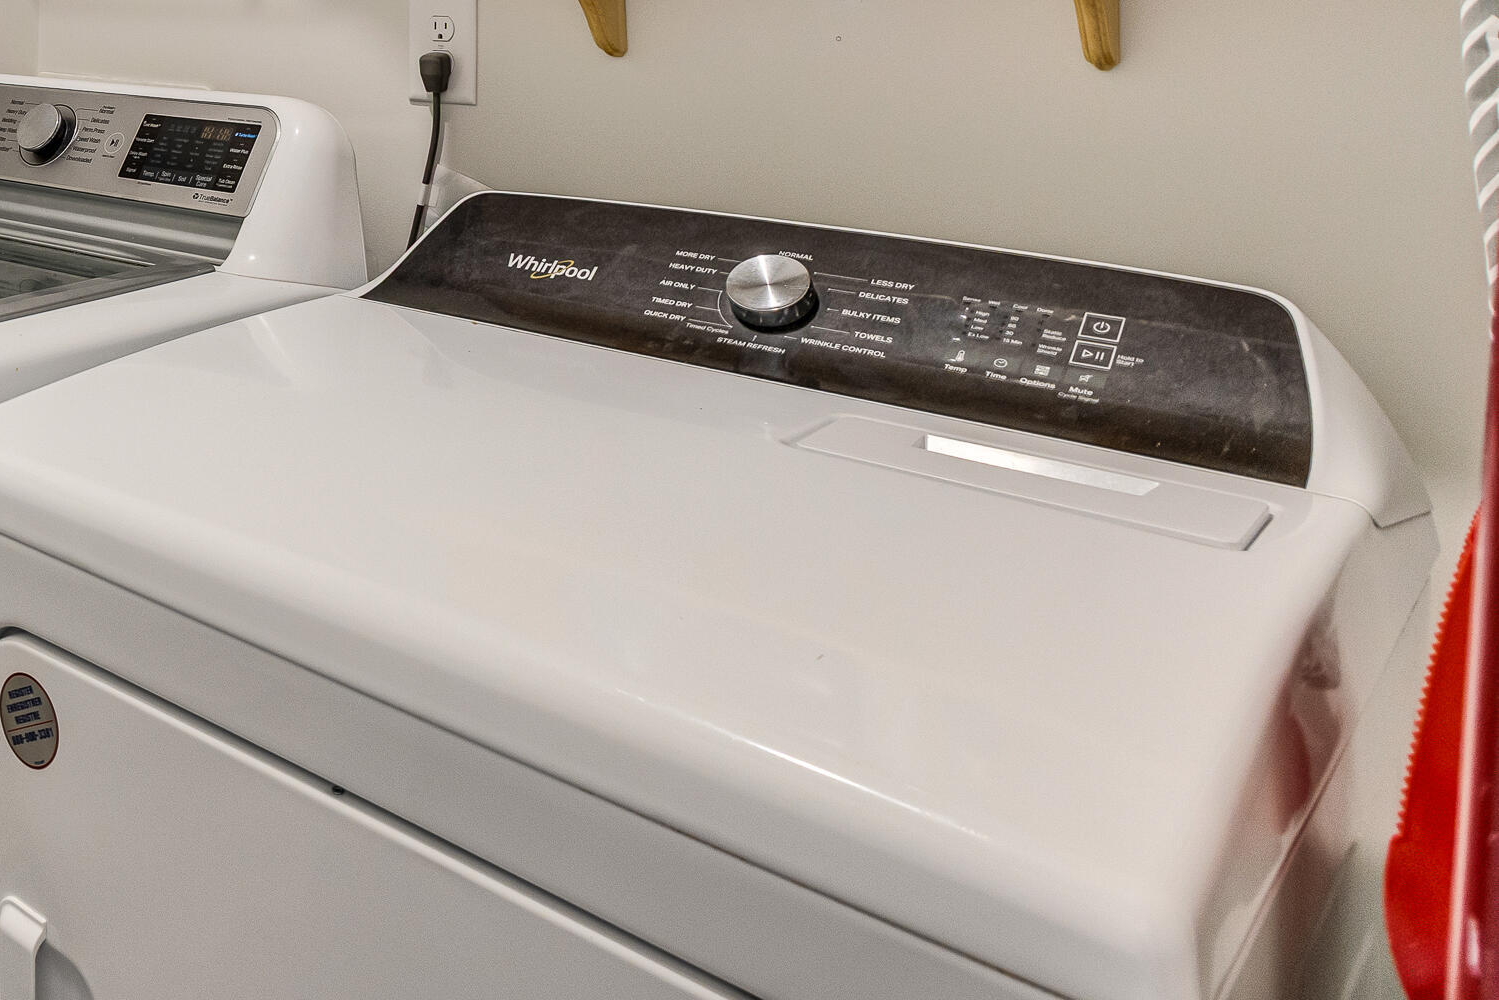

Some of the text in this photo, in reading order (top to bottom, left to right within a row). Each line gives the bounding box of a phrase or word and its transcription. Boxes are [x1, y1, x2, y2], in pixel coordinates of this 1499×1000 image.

[675, 250, 716, 262] MORE DRY
[778, 250, 814, 261] NORMAL
[507, 251, 599, 283] Whirlpool
[668, 262, 718, 275] HEAVY DUTY
[659, 278, 696, 291] AIR ONLY
[870, 278, 915, 291] LESS DRY
[651, 296, 694, 309] TIMED DRY
[858, 291, 910, 305] DELICATES
[643, 309, 687, 322] QUICK DRY
[841, 308, 902, 325] BULKY ITEMS
[685, 321, 729, 335] Timed Cycles
[853, 330, 894, 344] TOWELS
[716, 336, 786, 355] STEAM REFRESH
[800, 336, 887, 359] WRINKLE CONTROL
[1117, 354, 1135, 362] Hold
[943, 362, 968, 375] Temp
[984, 370, 1008, 381] Time
[1019, 376, 1056, 390] Options
[1068, 386, 1094, 397] Mute
